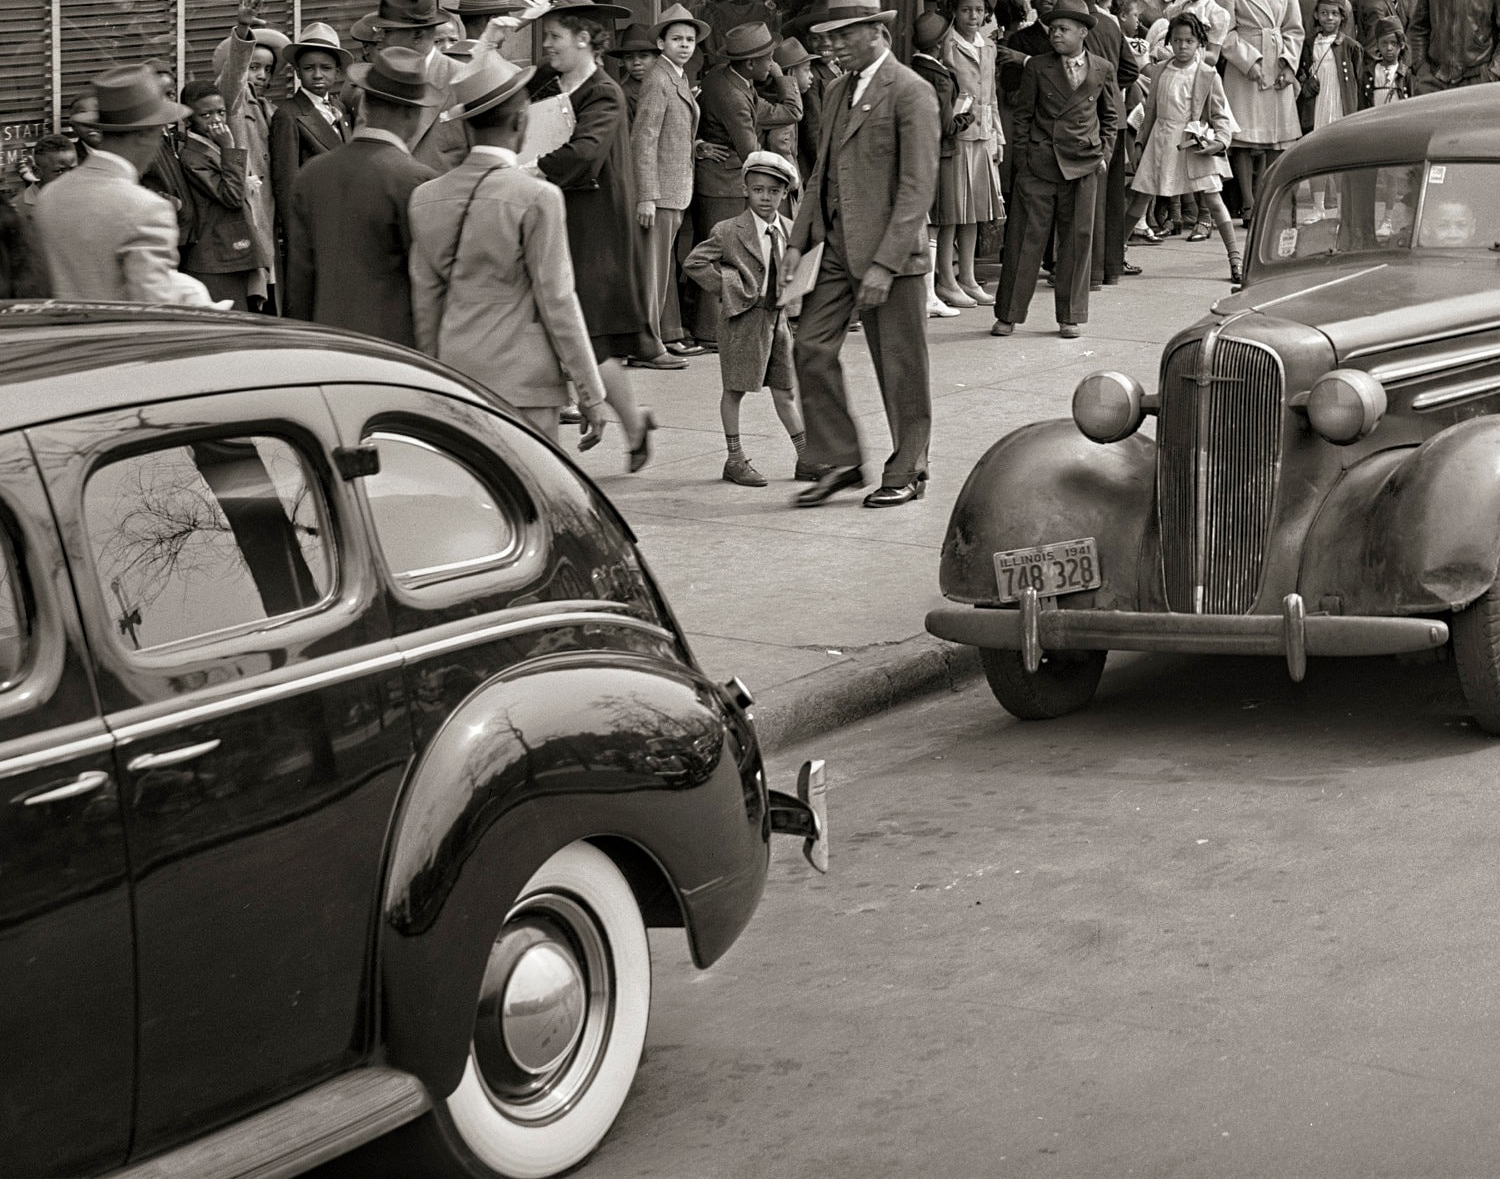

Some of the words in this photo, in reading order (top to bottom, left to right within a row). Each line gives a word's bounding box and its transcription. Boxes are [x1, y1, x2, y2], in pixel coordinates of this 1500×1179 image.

[1000, 551, 1055, 568] ILLINOIS
[1065, 545, 1091, 558] 1941
[1002, 563, 1044, 597] 748
[1053, 555, 1094, 589] 328
